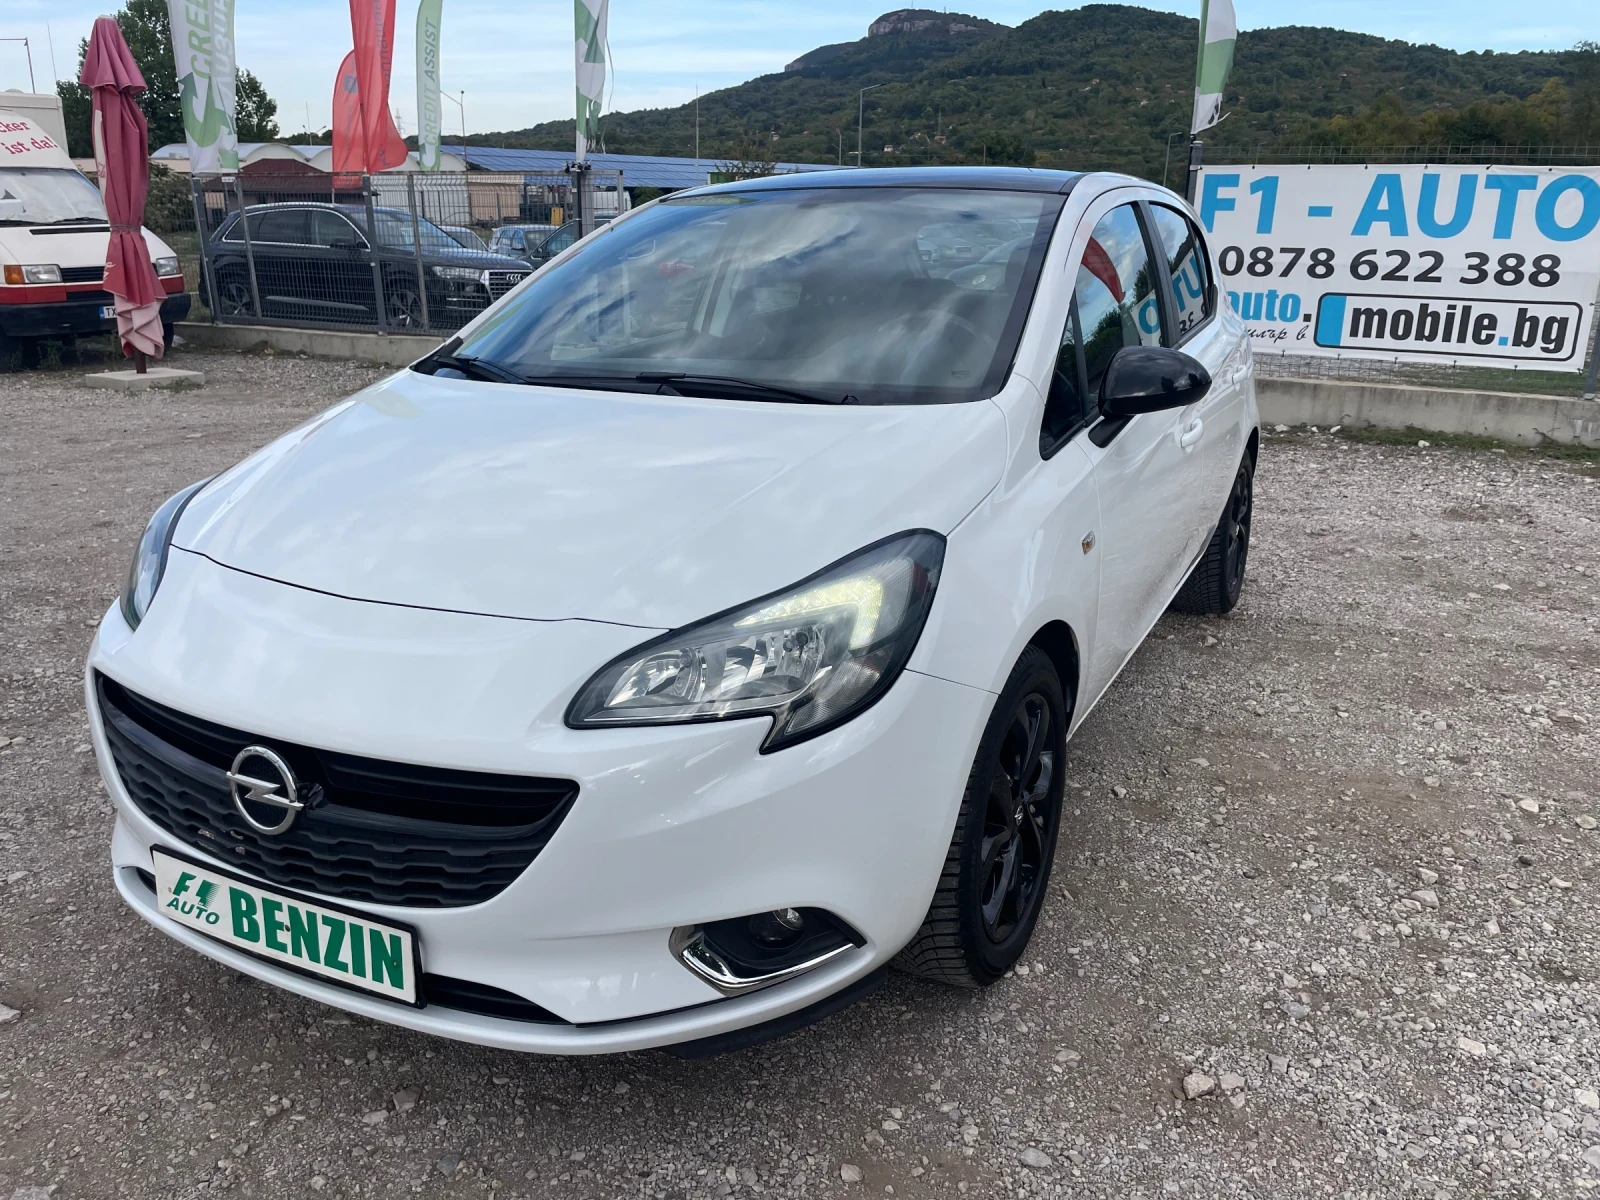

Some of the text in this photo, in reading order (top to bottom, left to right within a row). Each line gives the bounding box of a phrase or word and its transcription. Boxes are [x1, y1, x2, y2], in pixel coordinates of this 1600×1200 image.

[424, 17, 438, 146] CREDIT ASSIST
[1, 135, 59, 155] ist da!
[1200, 173, 1279, 234] F1
[1350, 173, 1600, 242] AUTO
[1219, 245, 1561, 287] 0878 622 388
[1247, 327, 1288, 343] илър
[1349, 303, 1570, 354] mobile.bg
[166, 897, 220, 925] AUTO
[172, 871, 404, 990] F1 BENZIN
